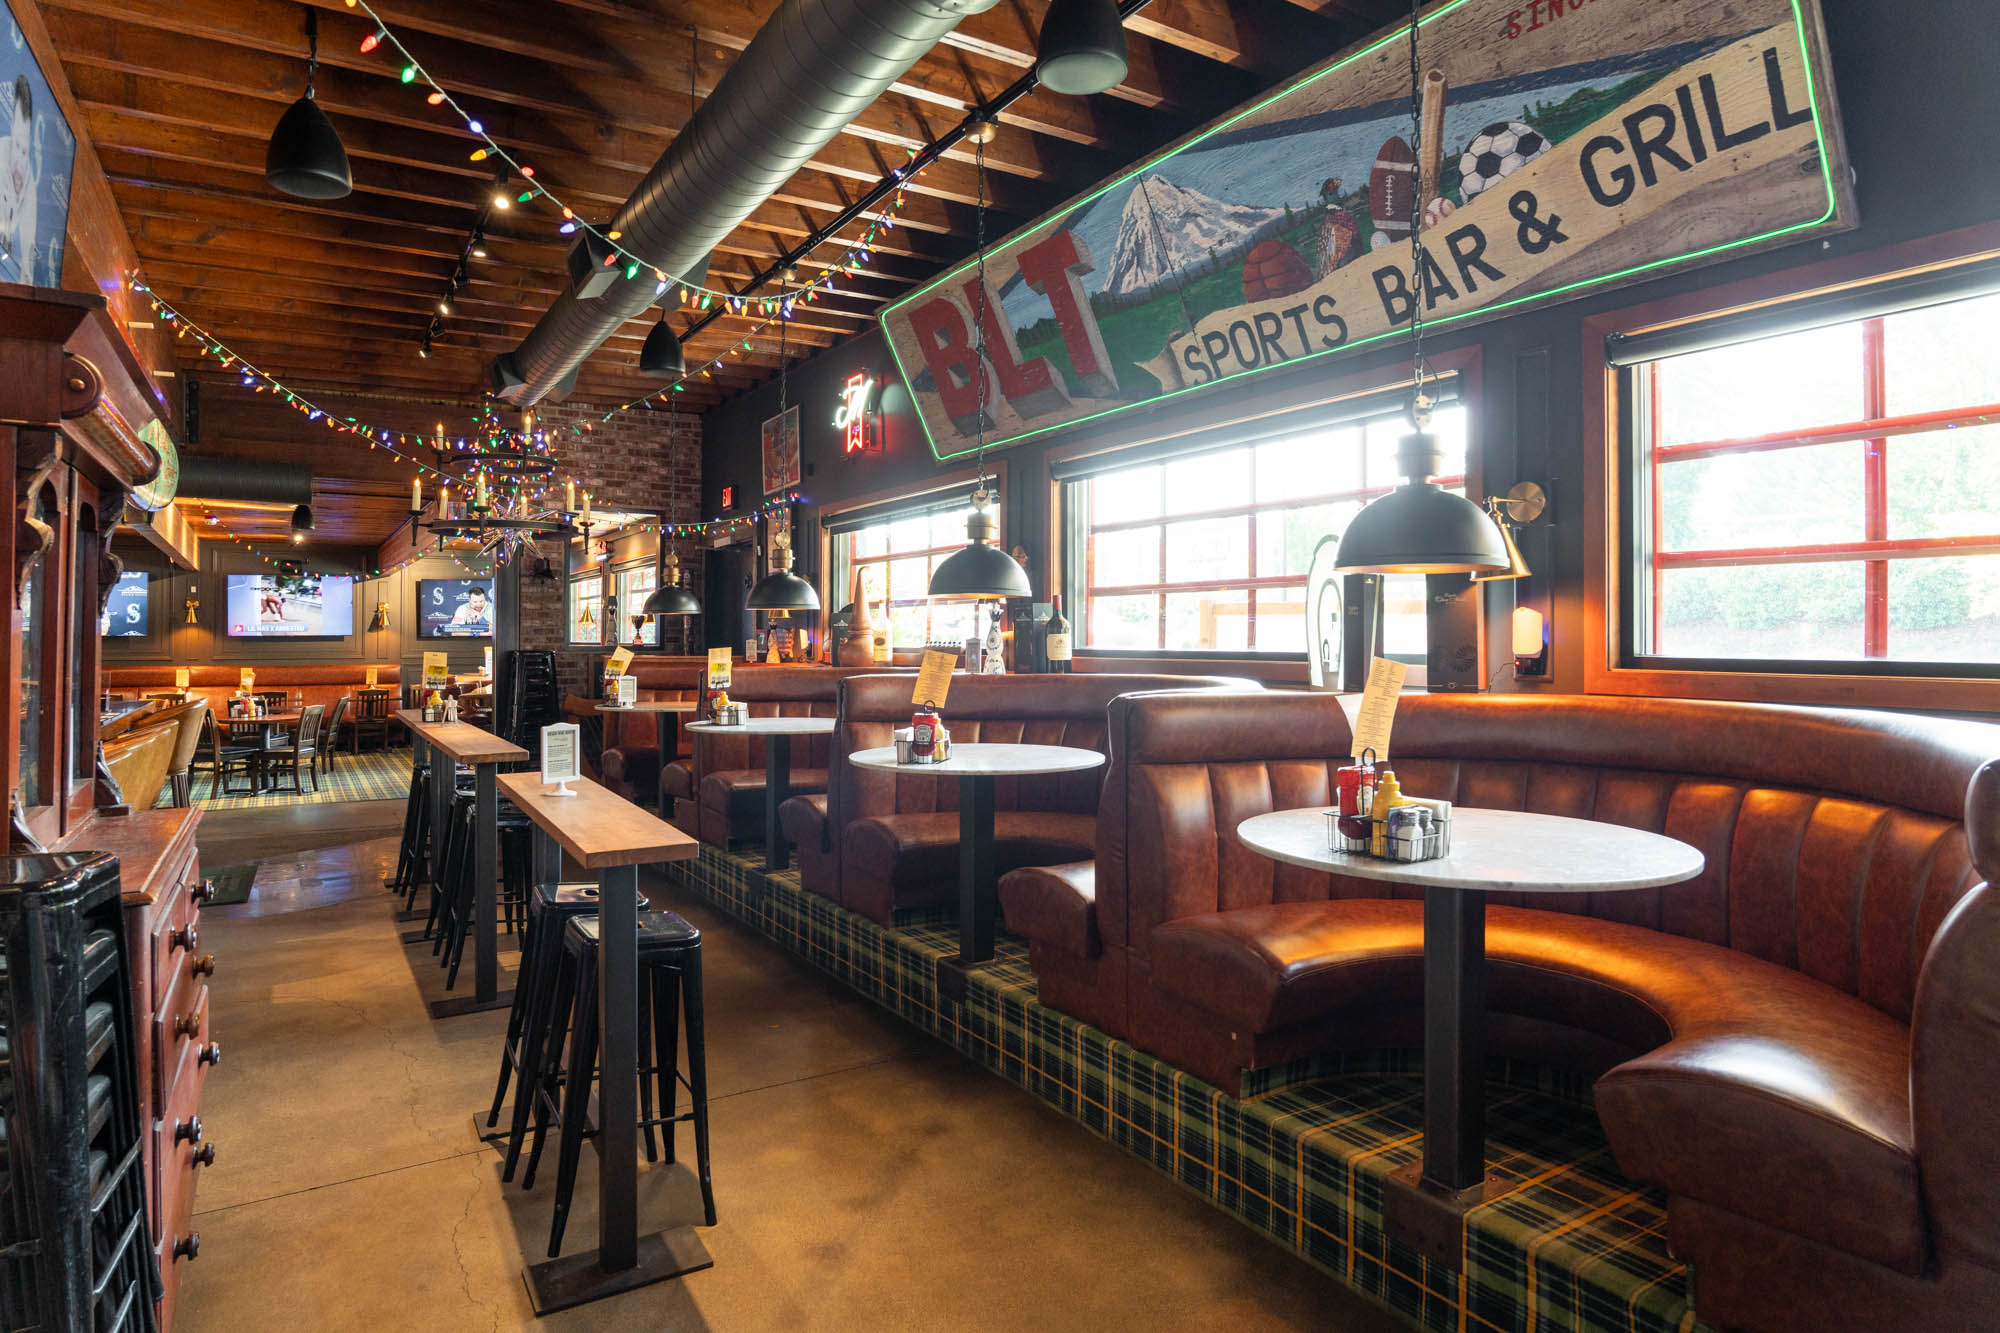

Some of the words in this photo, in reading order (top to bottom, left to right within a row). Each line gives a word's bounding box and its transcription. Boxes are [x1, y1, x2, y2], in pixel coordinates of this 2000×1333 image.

[1505, 0, 1597, 39] SIN
[1184, 294, 1348, 384] SPORTS
[1372, 223, 1507, 326] BAR
[1508, 190, 1569, 255] &
[1580, 46, 1814, 208] GRILL
[907, 229, 1108, 430] BLT
